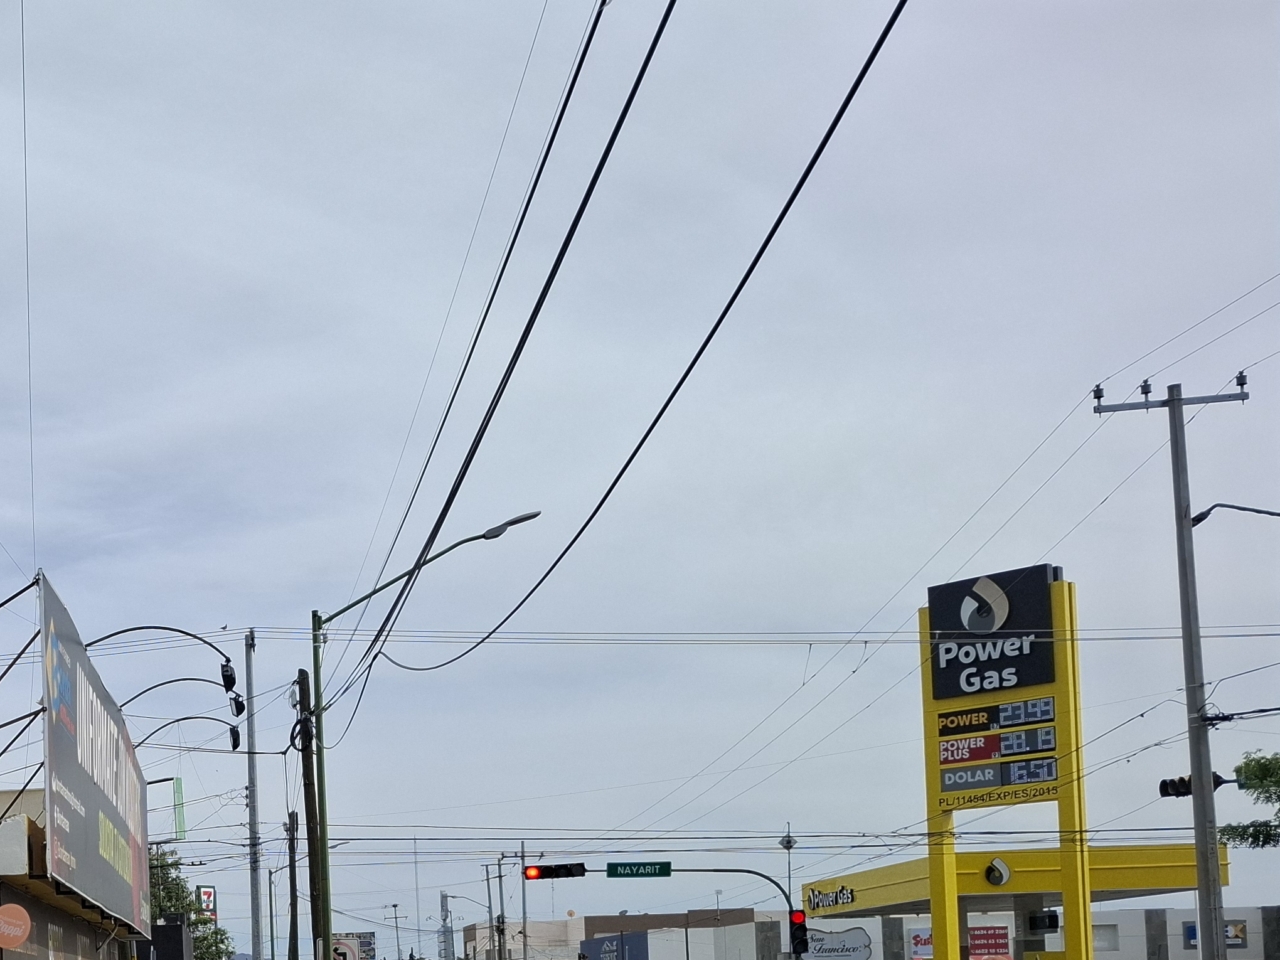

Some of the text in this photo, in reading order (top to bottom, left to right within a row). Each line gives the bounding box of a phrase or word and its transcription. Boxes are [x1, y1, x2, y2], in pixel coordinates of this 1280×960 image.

[939, 634, 1036, 669] Power
[959, 667, 1018, 693] Gas
[939, 712, 988, 729] POWER
[940, 737, 985, 752] POWER
[940, 749, 970, 762] PLUS
[944, 769, 994, 785] DOLAR
[617, 865, 661, 874] NAYARIT
[814, 885, 853, 909] Power Gas
[807, 933, 825, 943] San
[811, 942, 859, 954] Francisco
